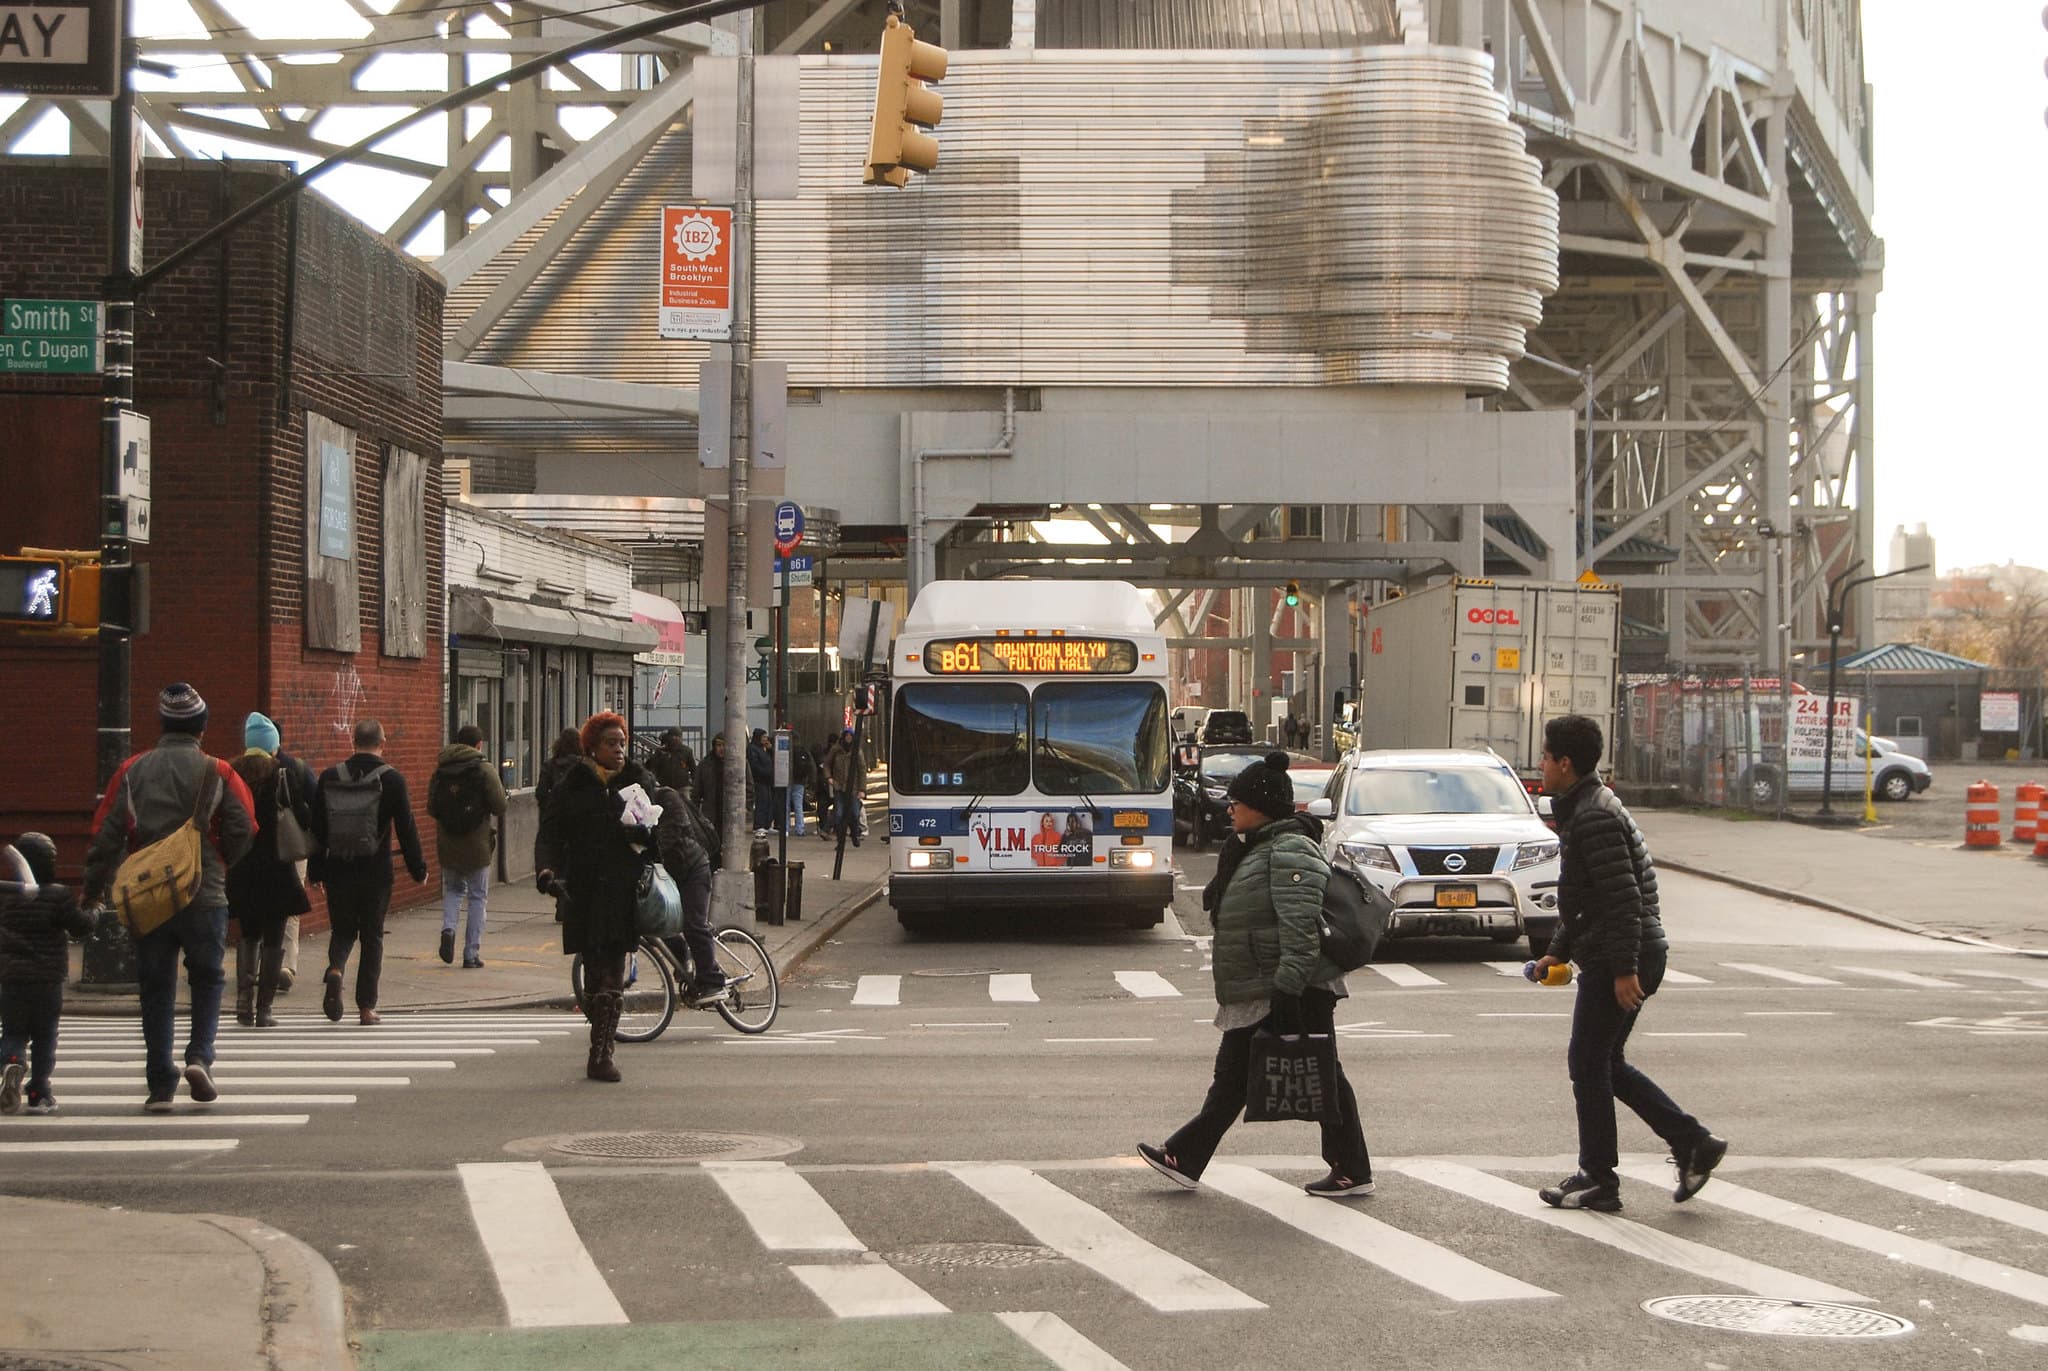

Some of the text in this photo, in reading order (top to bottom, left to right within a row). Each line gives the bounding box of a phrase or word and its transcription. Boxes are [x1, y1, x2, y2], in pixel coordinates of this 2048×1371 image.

[0, 13, 66, 57] AY
[684, 231, 709, 244] IBZ
[670, 263, 723, 273] South West
[670, 272, 713, 283] Brooklyn
[669, 289, 698, 297] Industrial
[699, 297, 716, 305] Zone
[11, 303, 94, 331] Smith St
[22, 340, 32, 357] C
[40, 340, 88, 363] Dugan
[7, 359, 48, 369] Boulevard
[790, 558, 806, 569] B61
[1467, 607, 1520, 625] OOCL
[941, 642, 1107, 672] B61 DOWNTOWN BKLYN
[1008, 656, 1092, 671] FULTON MALL
[1797, 699, 1819, 715] 24
[1795, 715, 1818, 726] ACTIVE
[918, 819, 937, 828] 472
[1033, 843, 1089, 854] TRUE ROCK
[1265, 1056, 1319, 1074] FREE
[1265, 1074, 1322, 1096] THE
[1265, 1096, 1323, 1113] FACE
